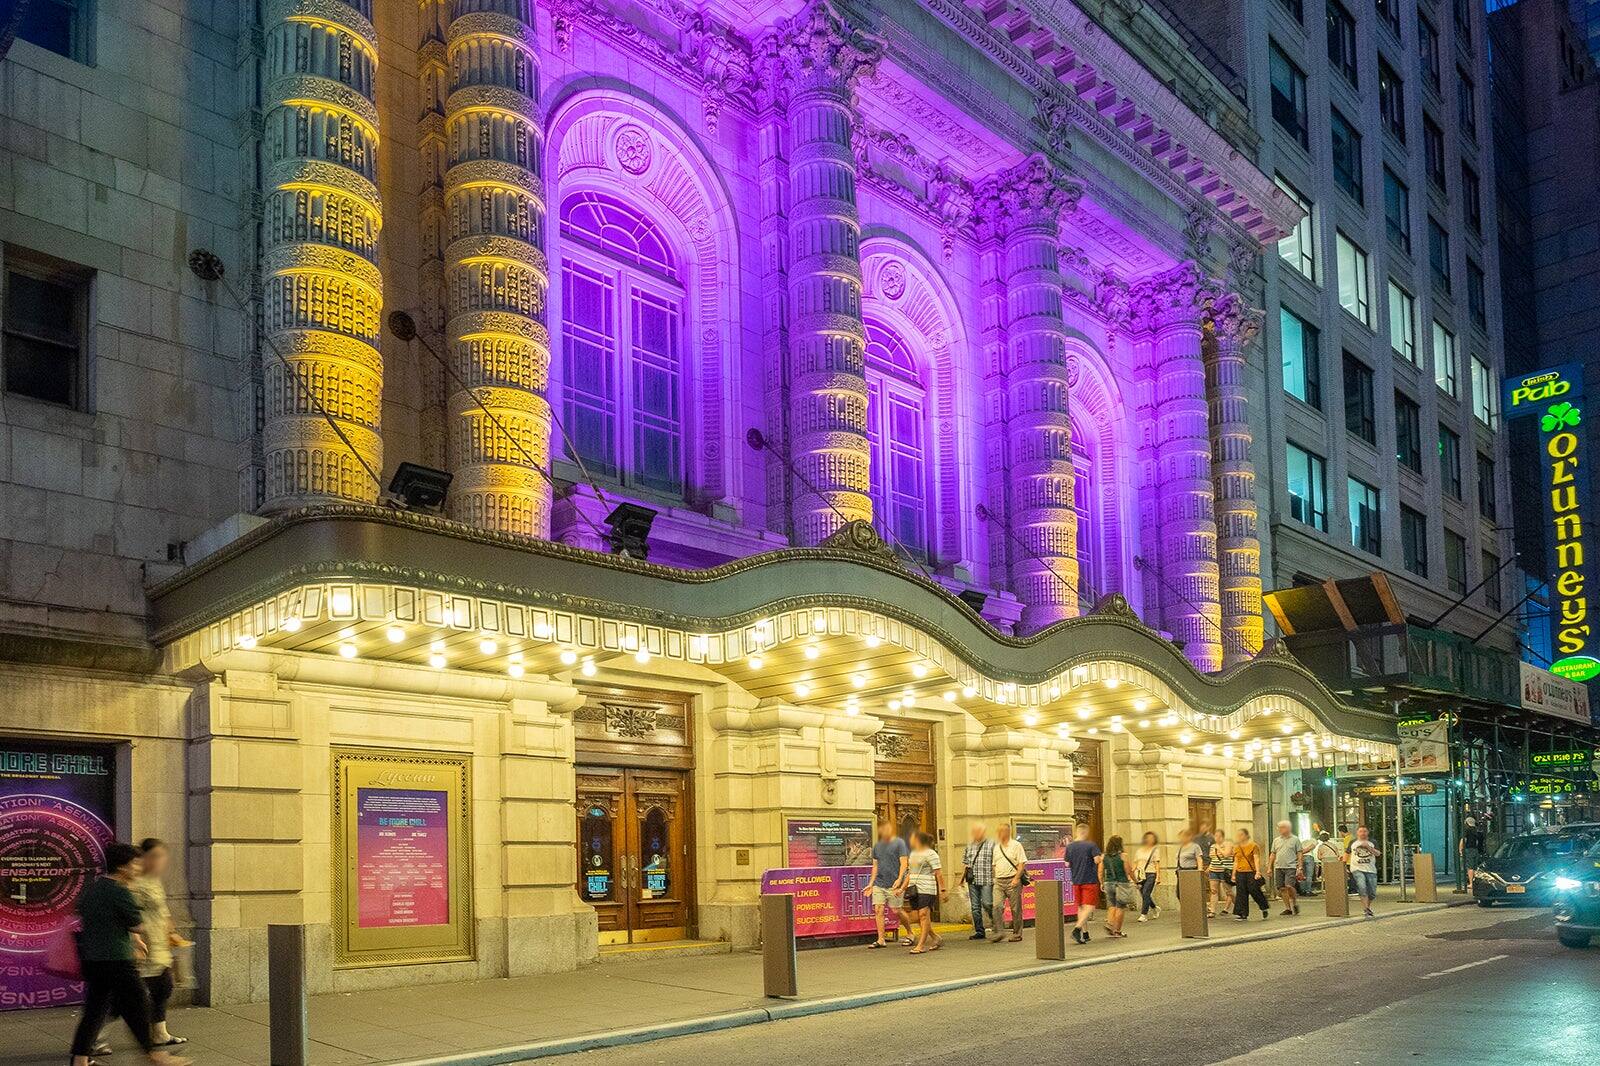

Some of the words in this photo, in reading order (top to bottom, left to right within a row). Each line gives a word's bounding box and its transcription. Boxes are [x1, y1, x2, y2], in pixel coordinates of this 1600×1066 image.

[1512, 380, 1571, 406] Pub
[1553, 662, 1596, 674] RESTAURANT
[368, 769, 437, 787] Lyceum
[0, 868, 71, 876] ENSATION!
[795, 875, 832, 884] FOLLOWED.
[841, 874, 855, 890] BE
[796, 889, 820, 898] LIKED.
